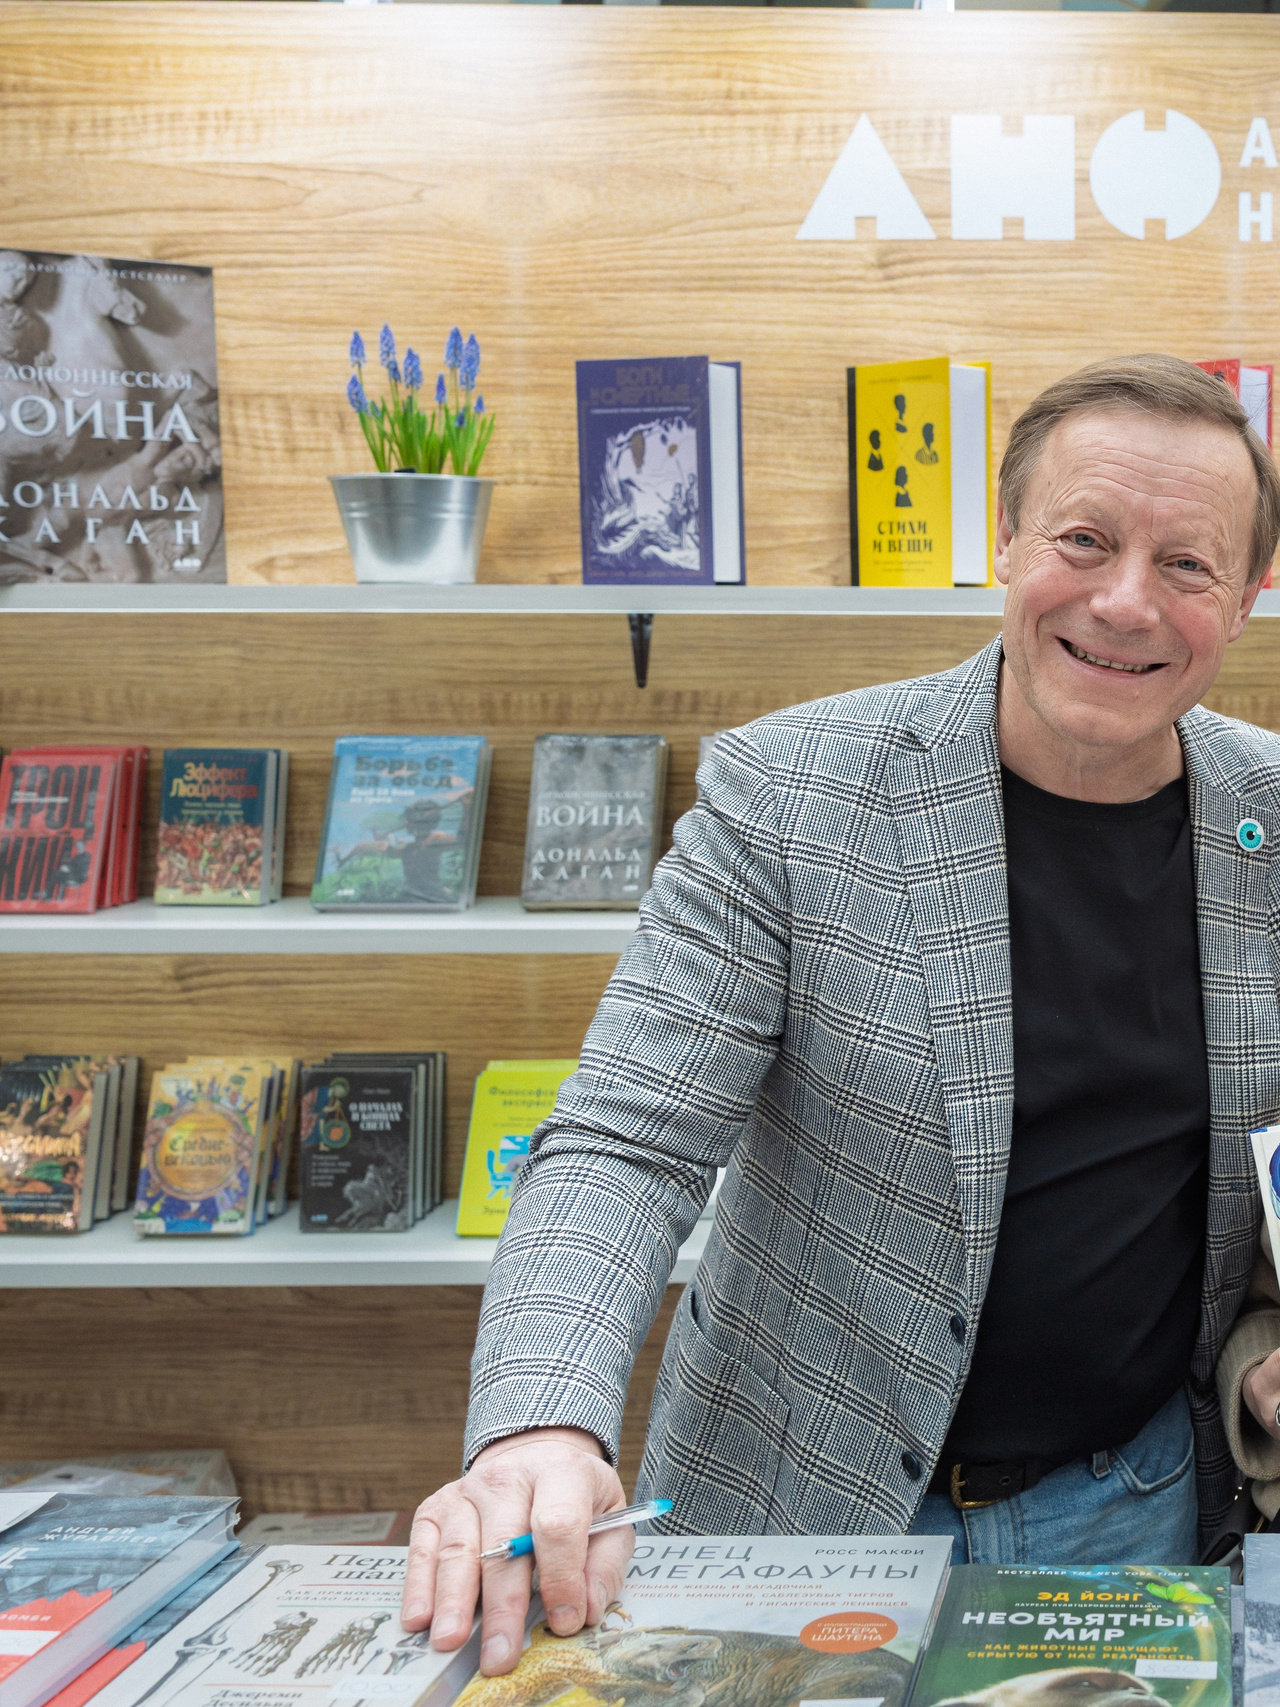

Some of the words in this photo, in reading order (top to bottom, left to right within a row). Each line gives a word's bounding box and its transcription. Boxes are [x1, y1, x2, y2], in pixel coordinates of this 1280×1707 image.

[877, 521, 927, 535] СТИХИ
[872, 540, 882, 552] И
[888, 539, 933, 554] ВЕЩИ
[536, 800, 644, 828] ВОЙНА
[532, 847, 641, 863] ДОНАЛЬД
[532, 864, 641, 881] КАГАН
[50, 1526, 138, 1535] АНДРЕЙ
[38, 1534, 158, 1543] ЖУРАВЛЕВ
[626, 1565, 919, 1579] МЕГАФАУНЫ
[1037, 1592, 1070, 1602] ЭД
[1080, 1590, 1143, 1602] ЙОНГ
[962, 1612, 1209, 1627] НЕОБЪЯТНЫЙ
[1044, 1628, 1126, 1642] МИР
[1017, 1644, 1097, 1652] ЖИВОТНЫЕ
[1102, 1645, 1179, 1653] ОЩУЩАЮТ
[967, 1651, 1038, 1659] СКРЫТУЮ
[1102, 1652, 1195, 1661] РЕАЛЬНОСТЬ
